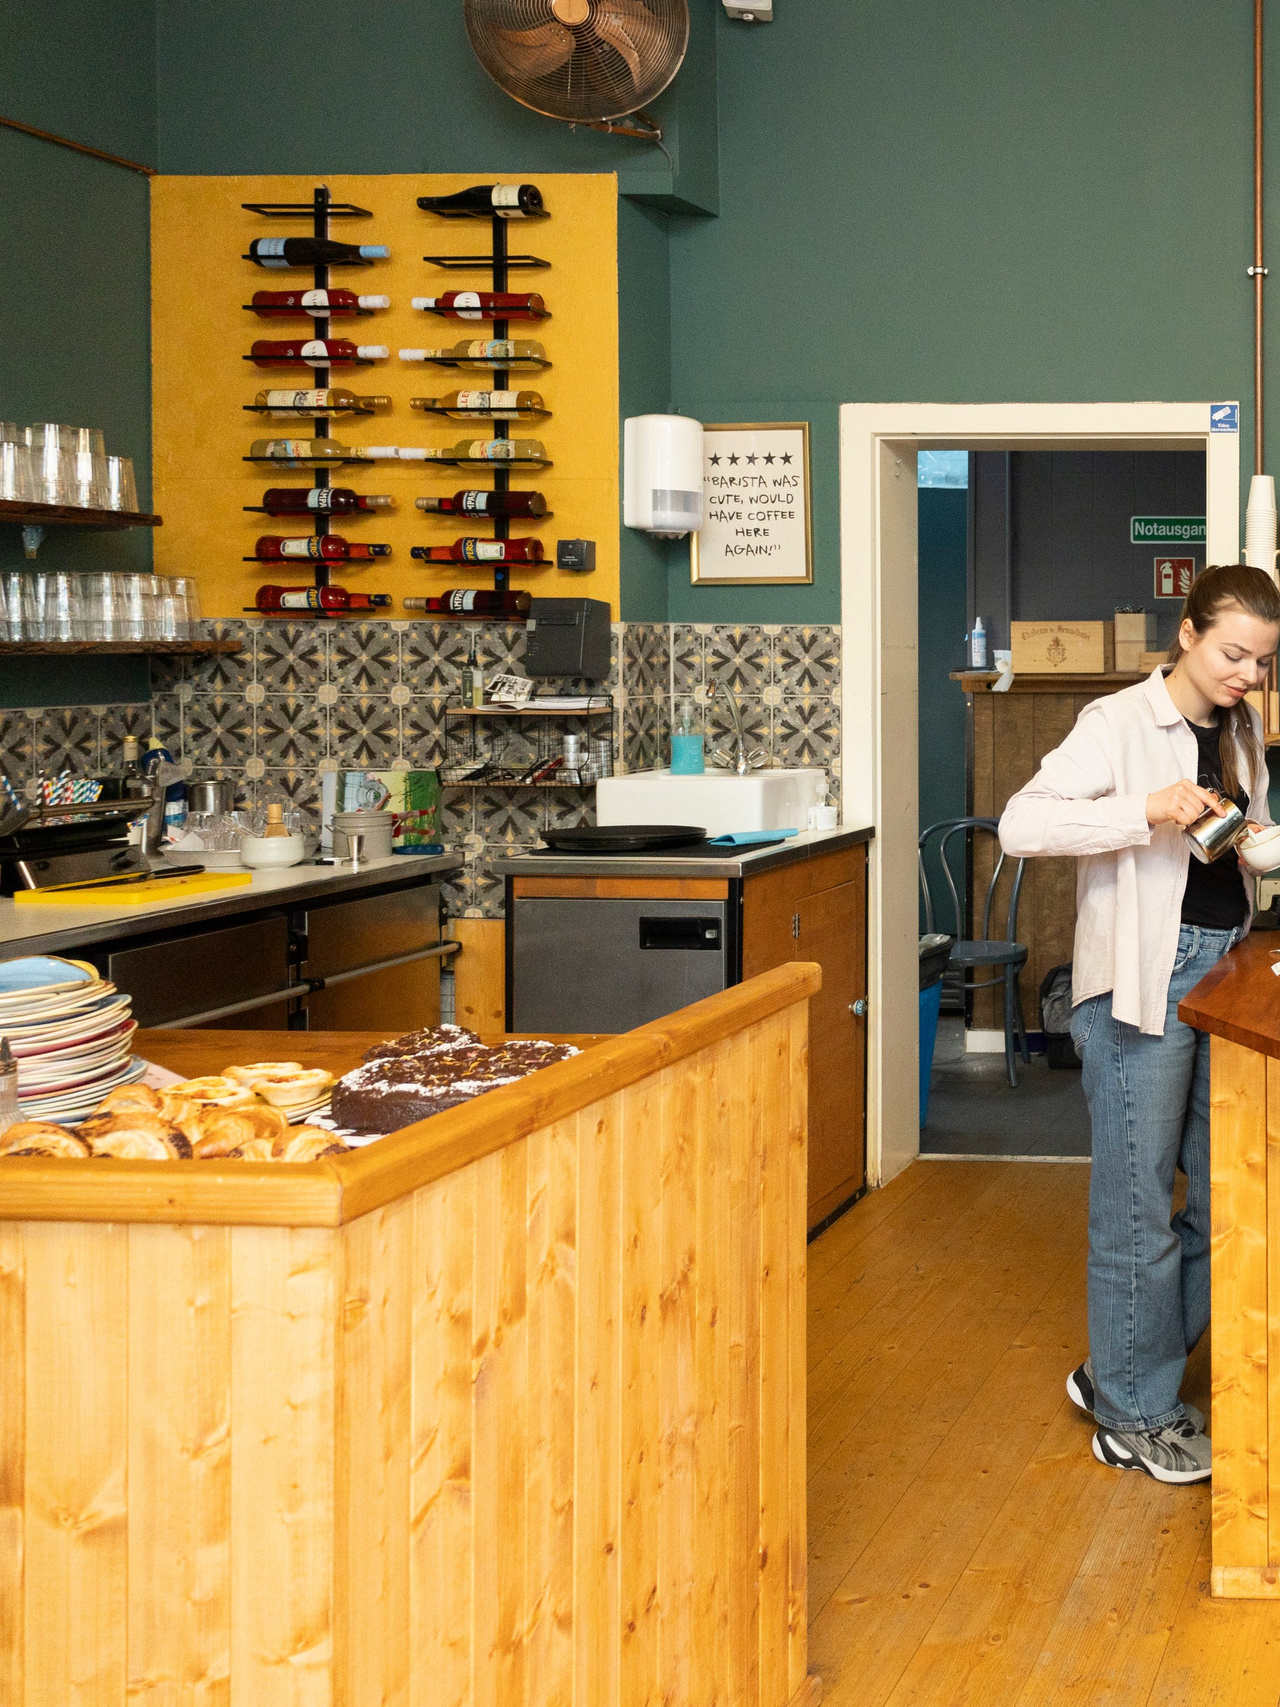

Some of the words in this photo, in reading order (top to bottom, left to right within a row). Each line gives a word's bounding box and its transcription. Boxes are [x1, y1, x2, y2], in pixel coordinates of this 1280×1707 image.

[772, 474, 800, 487] WAS
[709, 494, 744, 505] CUTE,
[748, 493, 794, 504] WOULD
[709, 510, 743, 523] HAVE
[747, 510, 795, 521] COFFEE
[735, 528, 770, 537] HERE
[1134, 521, 1206, 539] Notausgan
[309, 535, 320, 557] APERO
[465, 539, 476, 559] PEROL
[308, 588, 318, 608] APER
